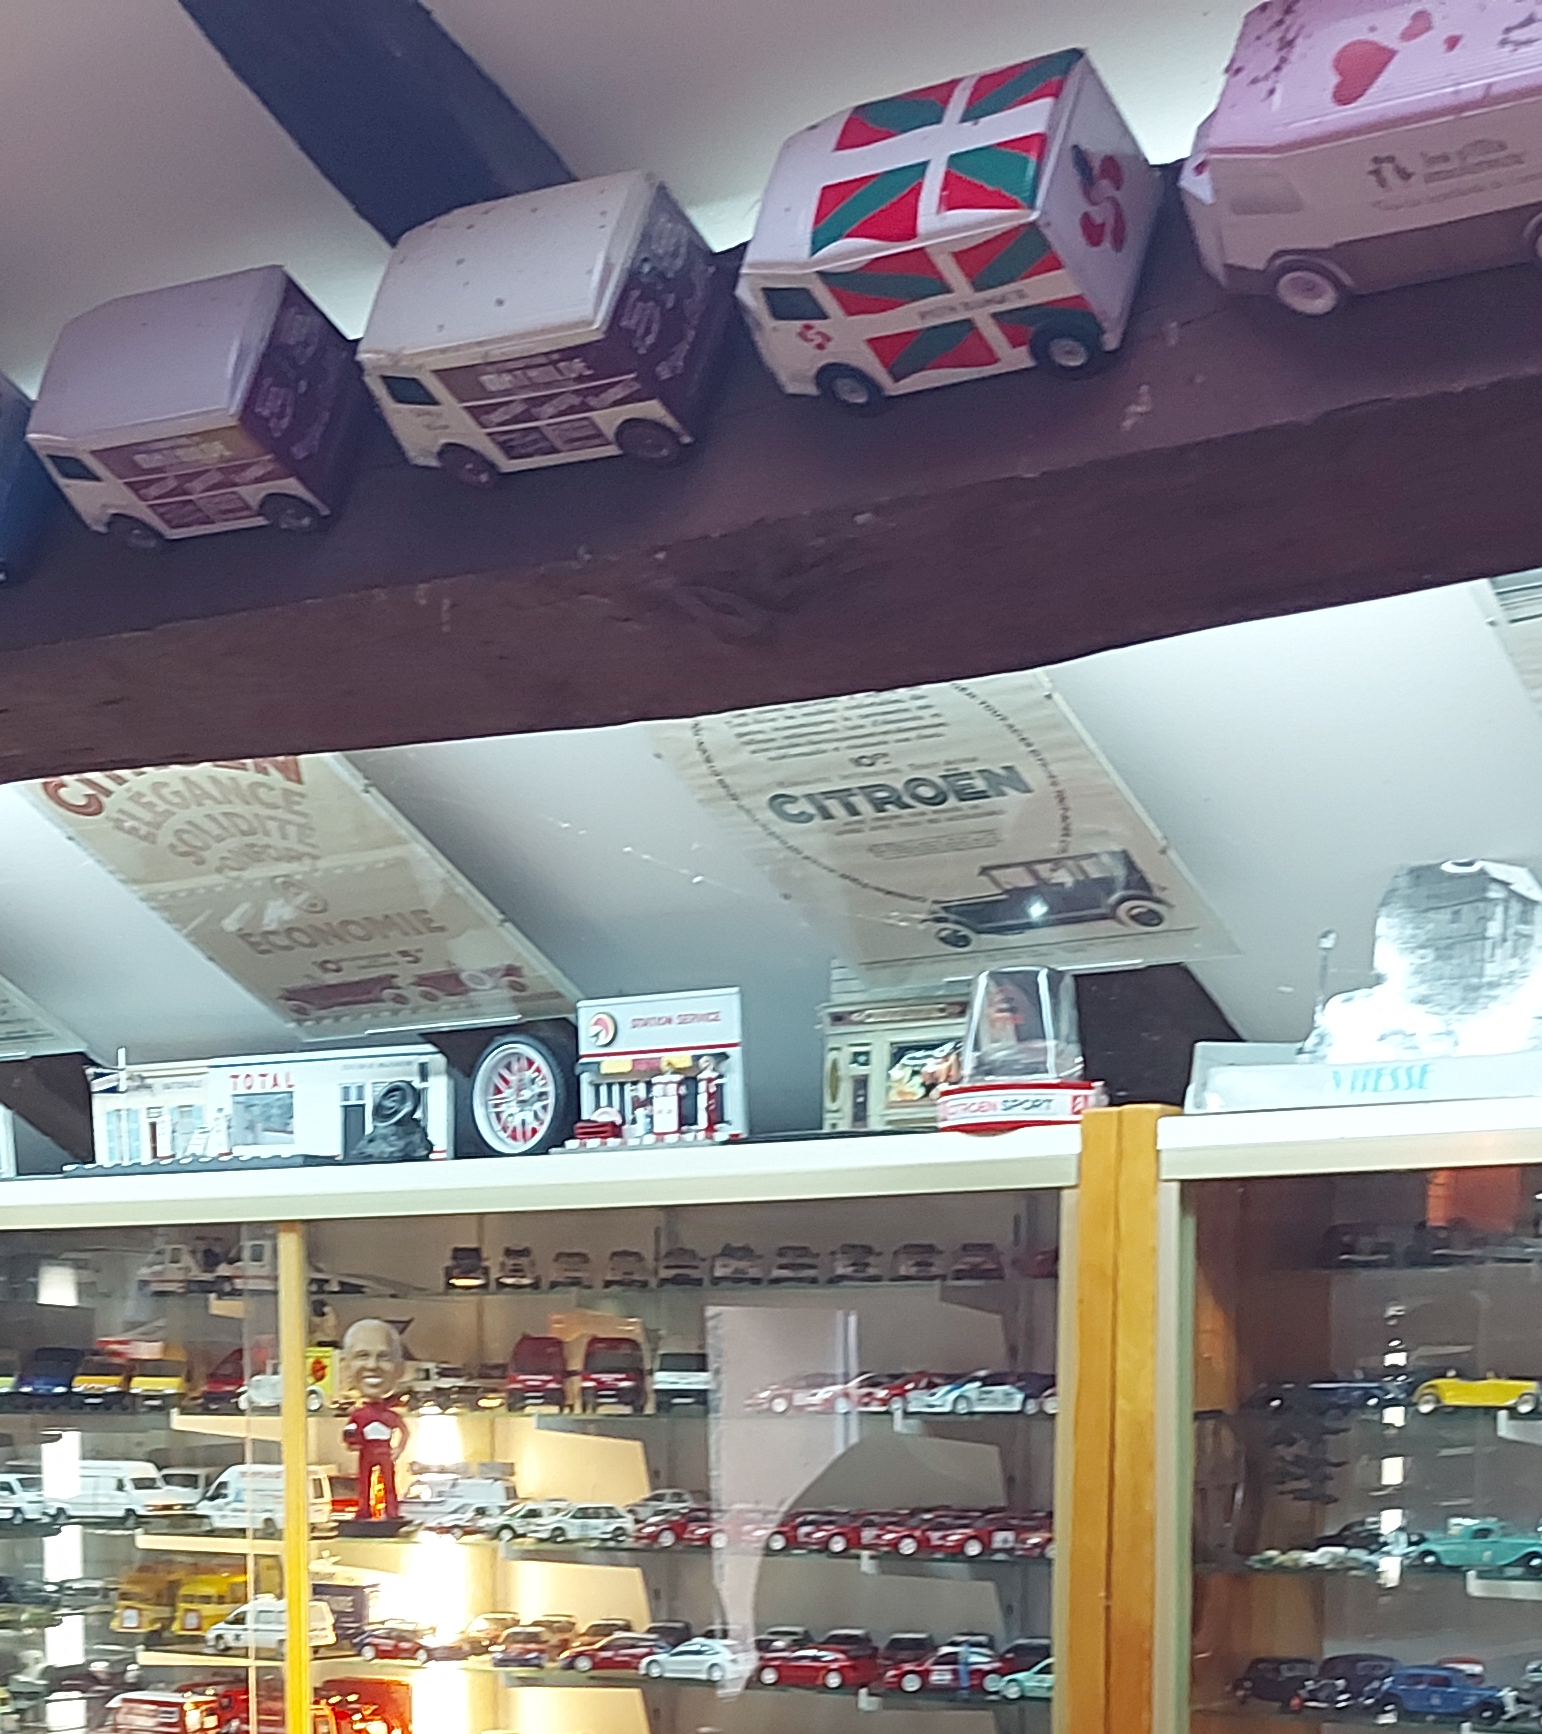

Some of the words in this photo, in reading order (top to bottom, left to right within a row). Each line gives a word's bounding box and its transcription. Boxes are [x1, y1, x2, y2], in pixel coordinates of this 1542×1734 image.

[767, 765, 1035, 824] CITROËN
[630, 1016, 673, 1029] STATION
[675, 1011, 721, 1025] SERVICE
[229, 1072, 295, 1091] TOTAL
